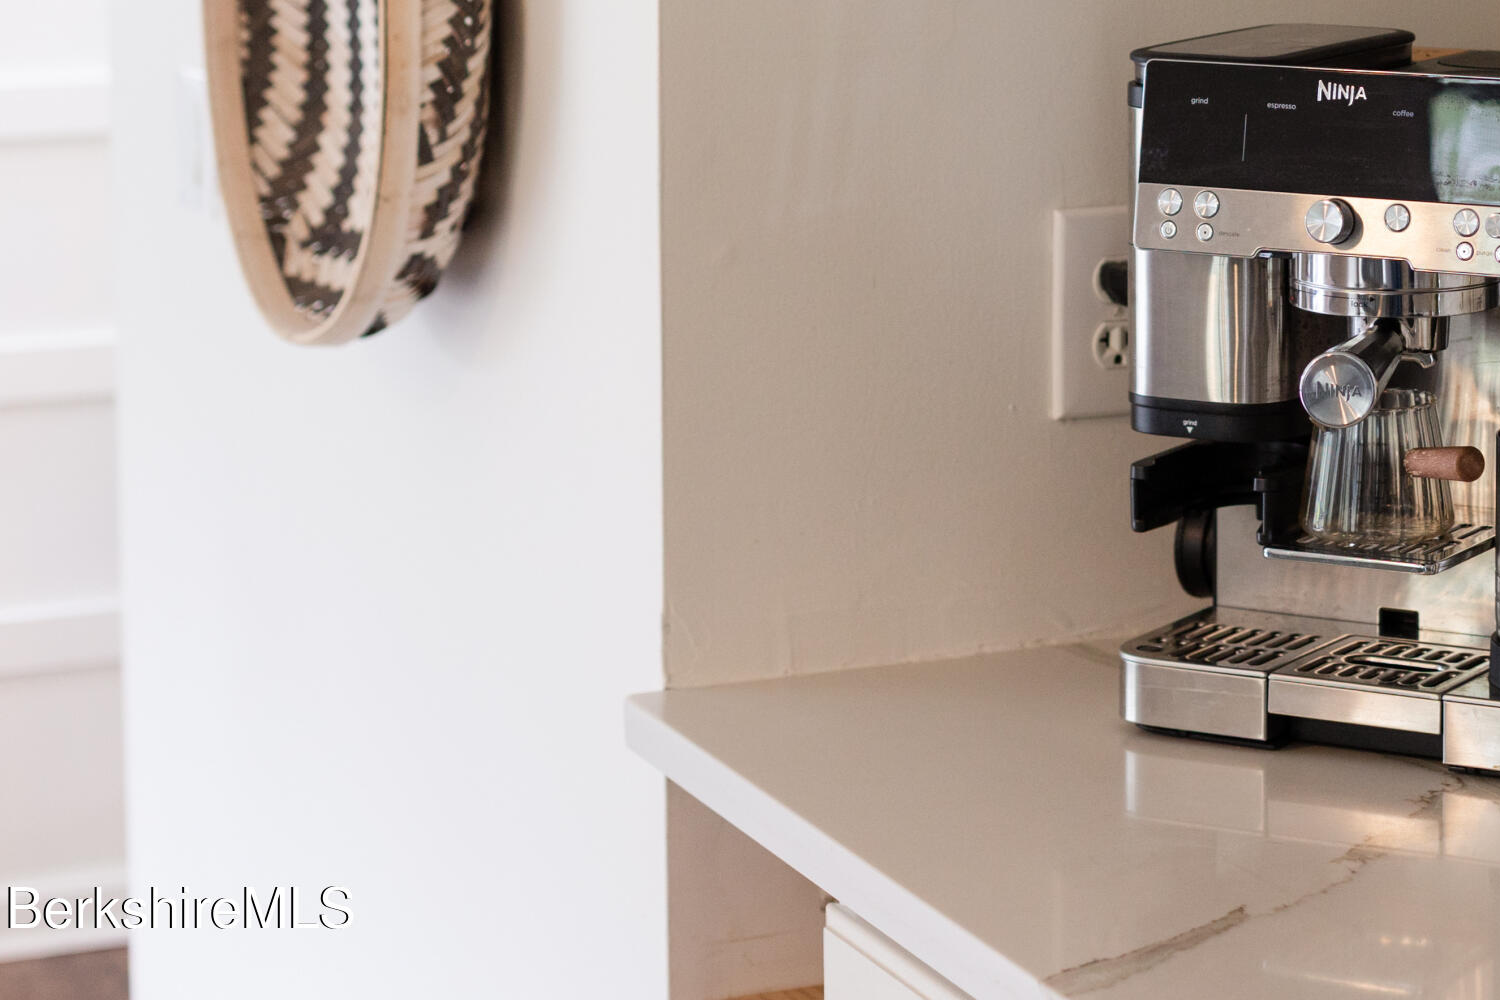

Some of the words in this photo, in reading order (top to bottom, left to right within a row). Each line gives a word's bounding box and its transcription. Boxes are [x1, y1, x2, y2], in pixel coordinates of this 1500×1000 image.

[1316, 79, 1368, 106] NINJA
[1190, 97, 1209, 105] grind
[1266, 101, 1297, 111] espresso
[1392, 109, 1415, 118] coffee
[1315, 380, 1362, 402] NINJA
